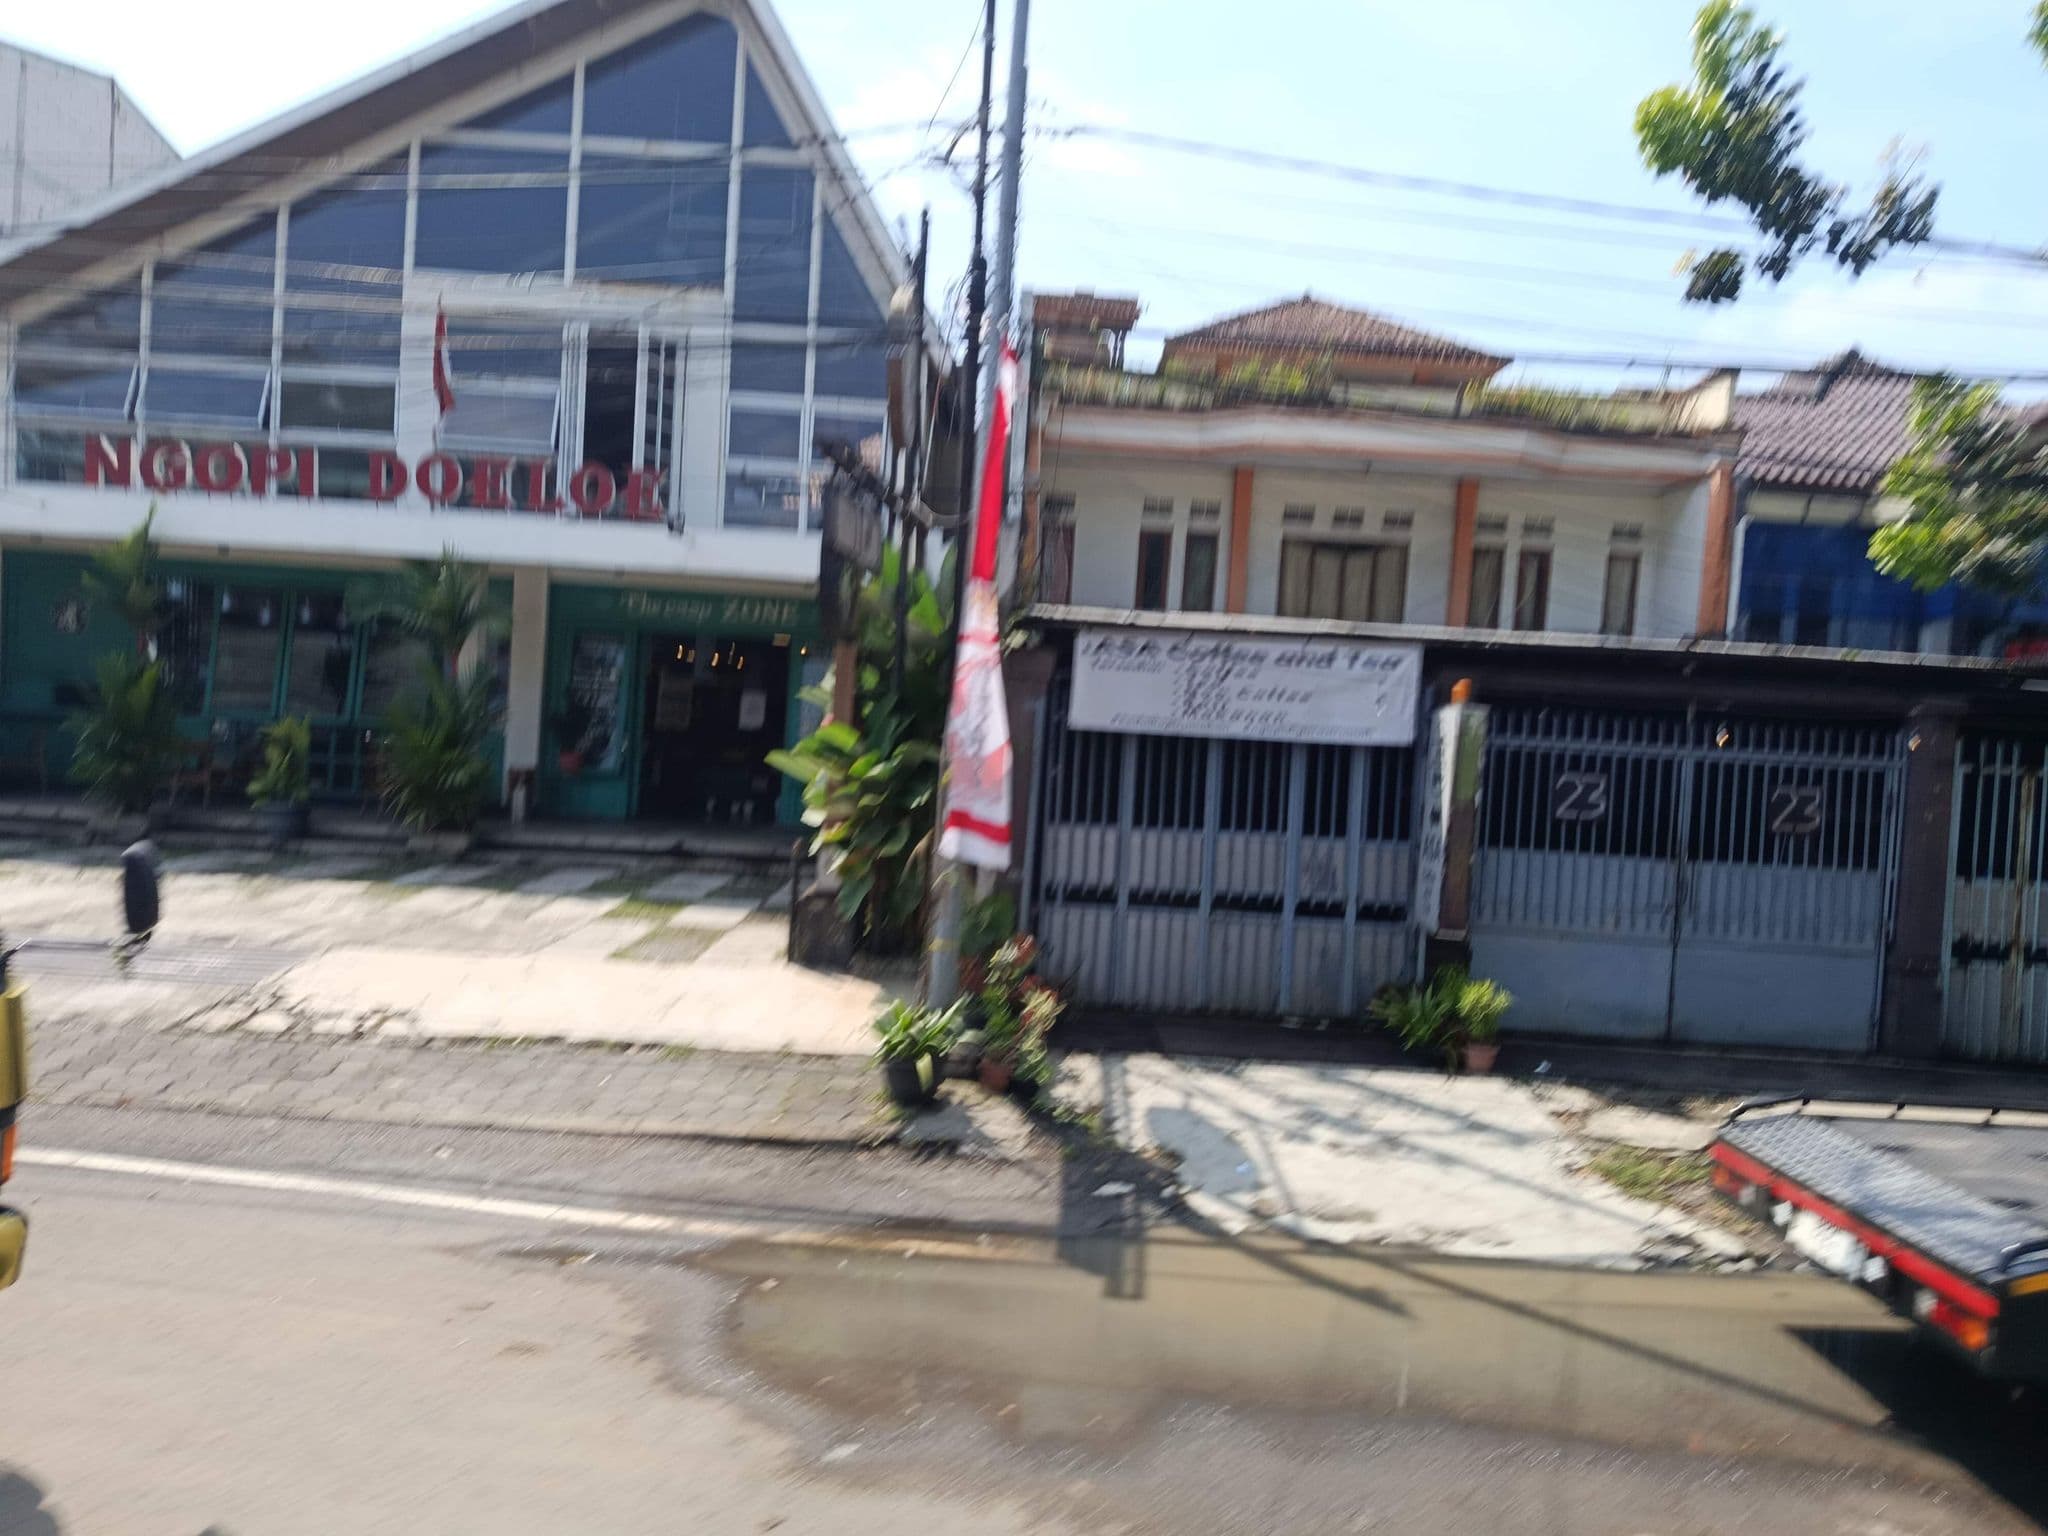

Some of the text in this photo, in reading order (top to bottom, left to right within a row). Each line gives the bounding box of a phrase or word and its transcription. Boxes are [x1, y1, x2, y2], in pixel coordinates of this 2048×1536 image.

[84, 434, 668, 523] NGOPI DOELOE
[1274, 646, 1339, 669] and
[1346, 650, 1404, 672] Tea
[1555, 772, 1607, 820] 23
[1771, 785, 1822, 833] 23
